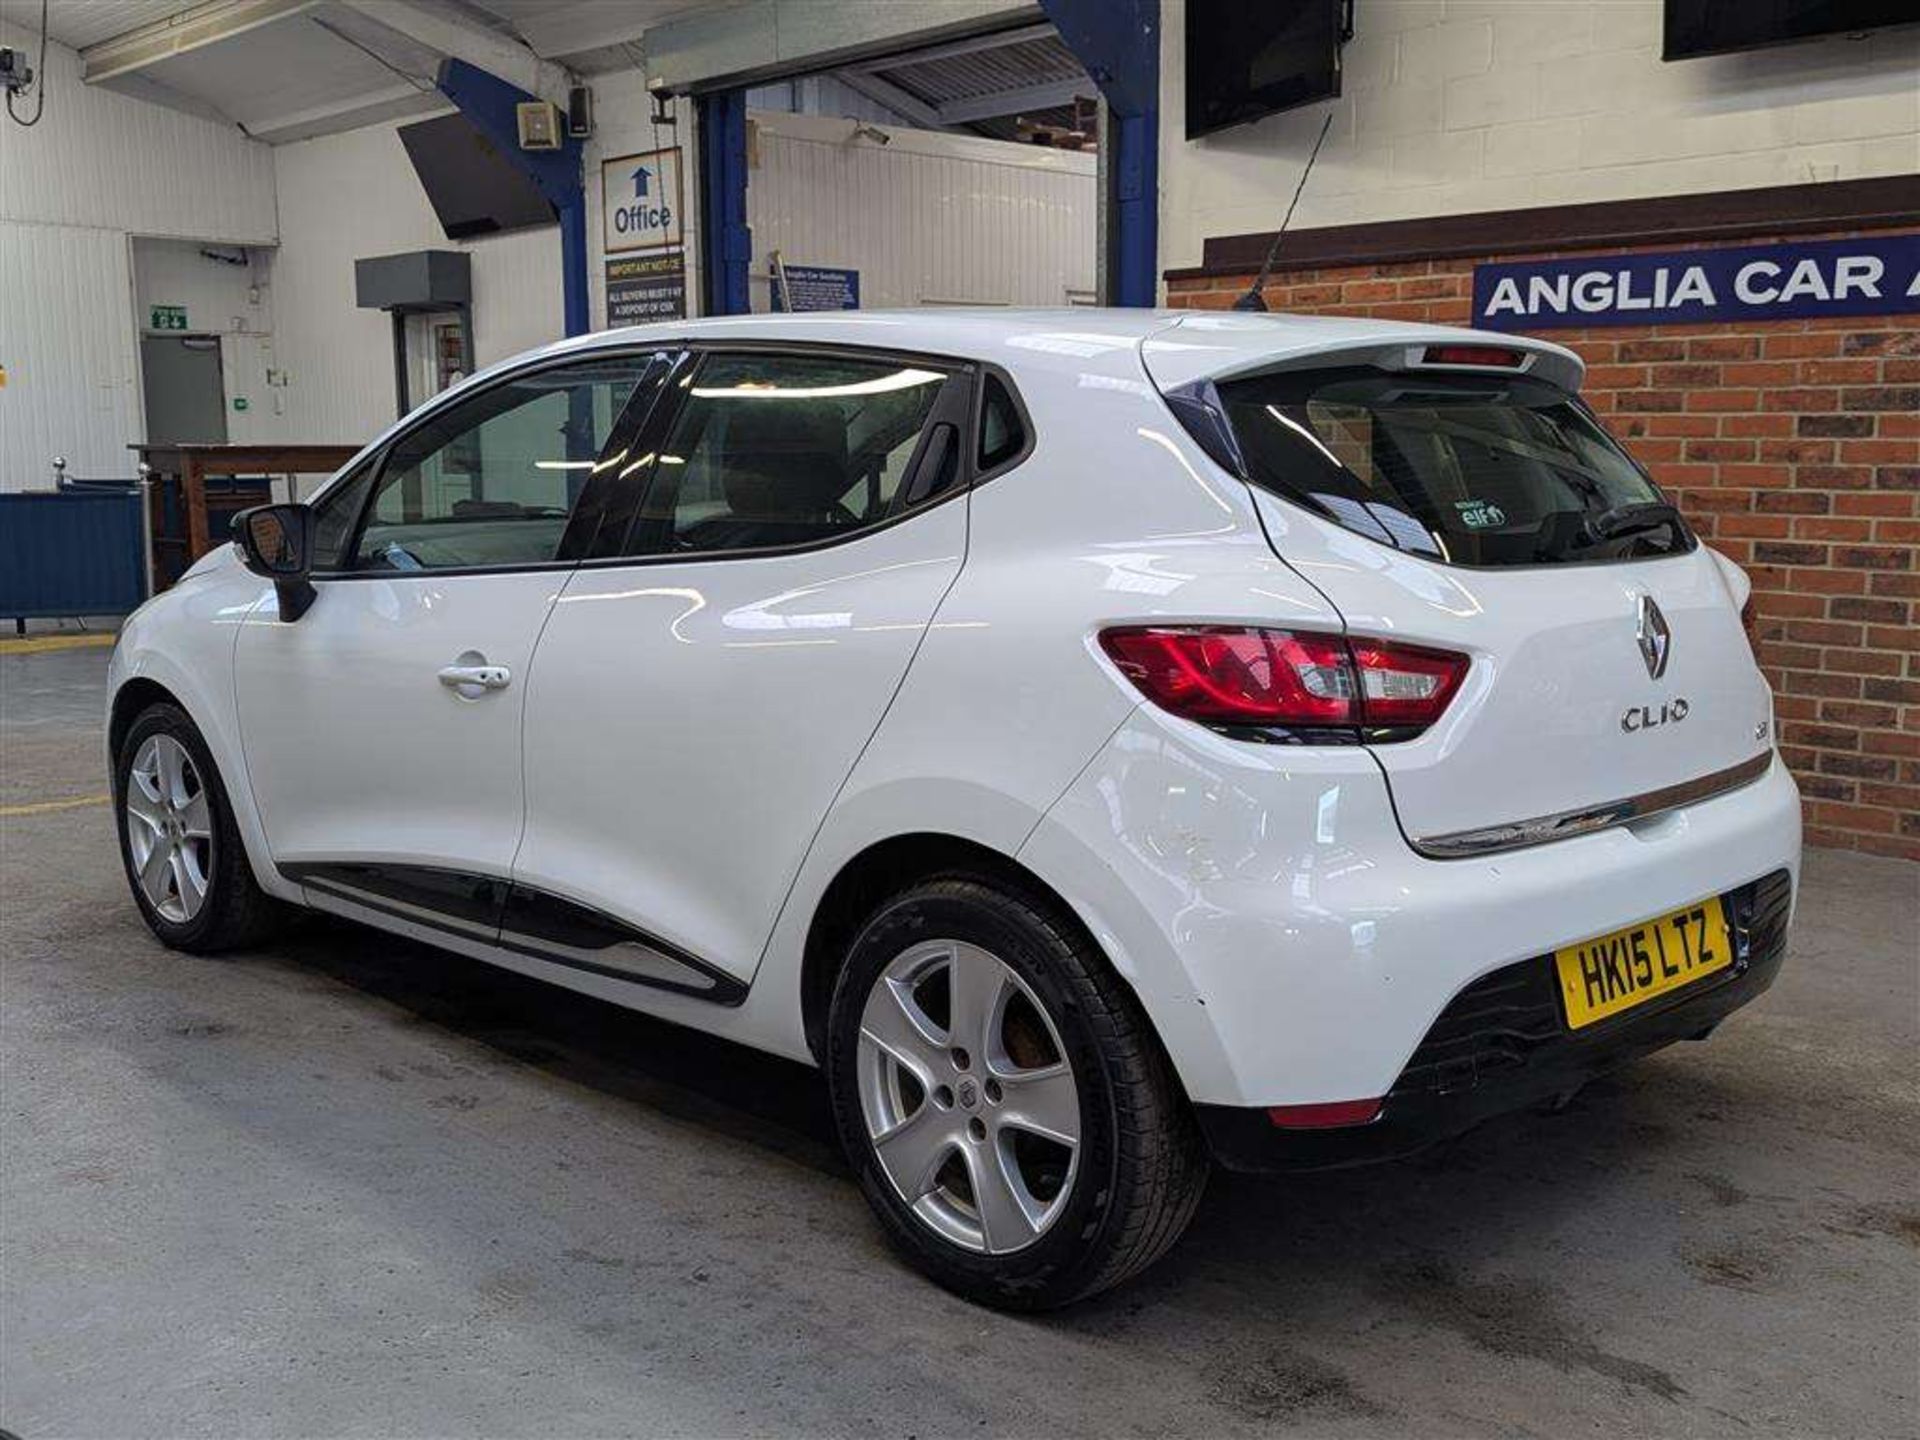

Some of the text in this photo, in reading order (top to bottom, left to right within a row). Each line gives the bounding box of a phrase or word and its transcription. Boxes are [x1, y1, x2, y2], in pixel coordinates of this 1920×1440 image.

[614, 204, 671, 234] Office
[1484, 266, 1718, 317] ANGLIA
[1733, 255, 1884, 305] CAR
[1462, 507, 1488, 527] elf
[1620, 698, 1690, 733] CLIO
[1578, 908, 1715, 1009] HK15 LTZ
